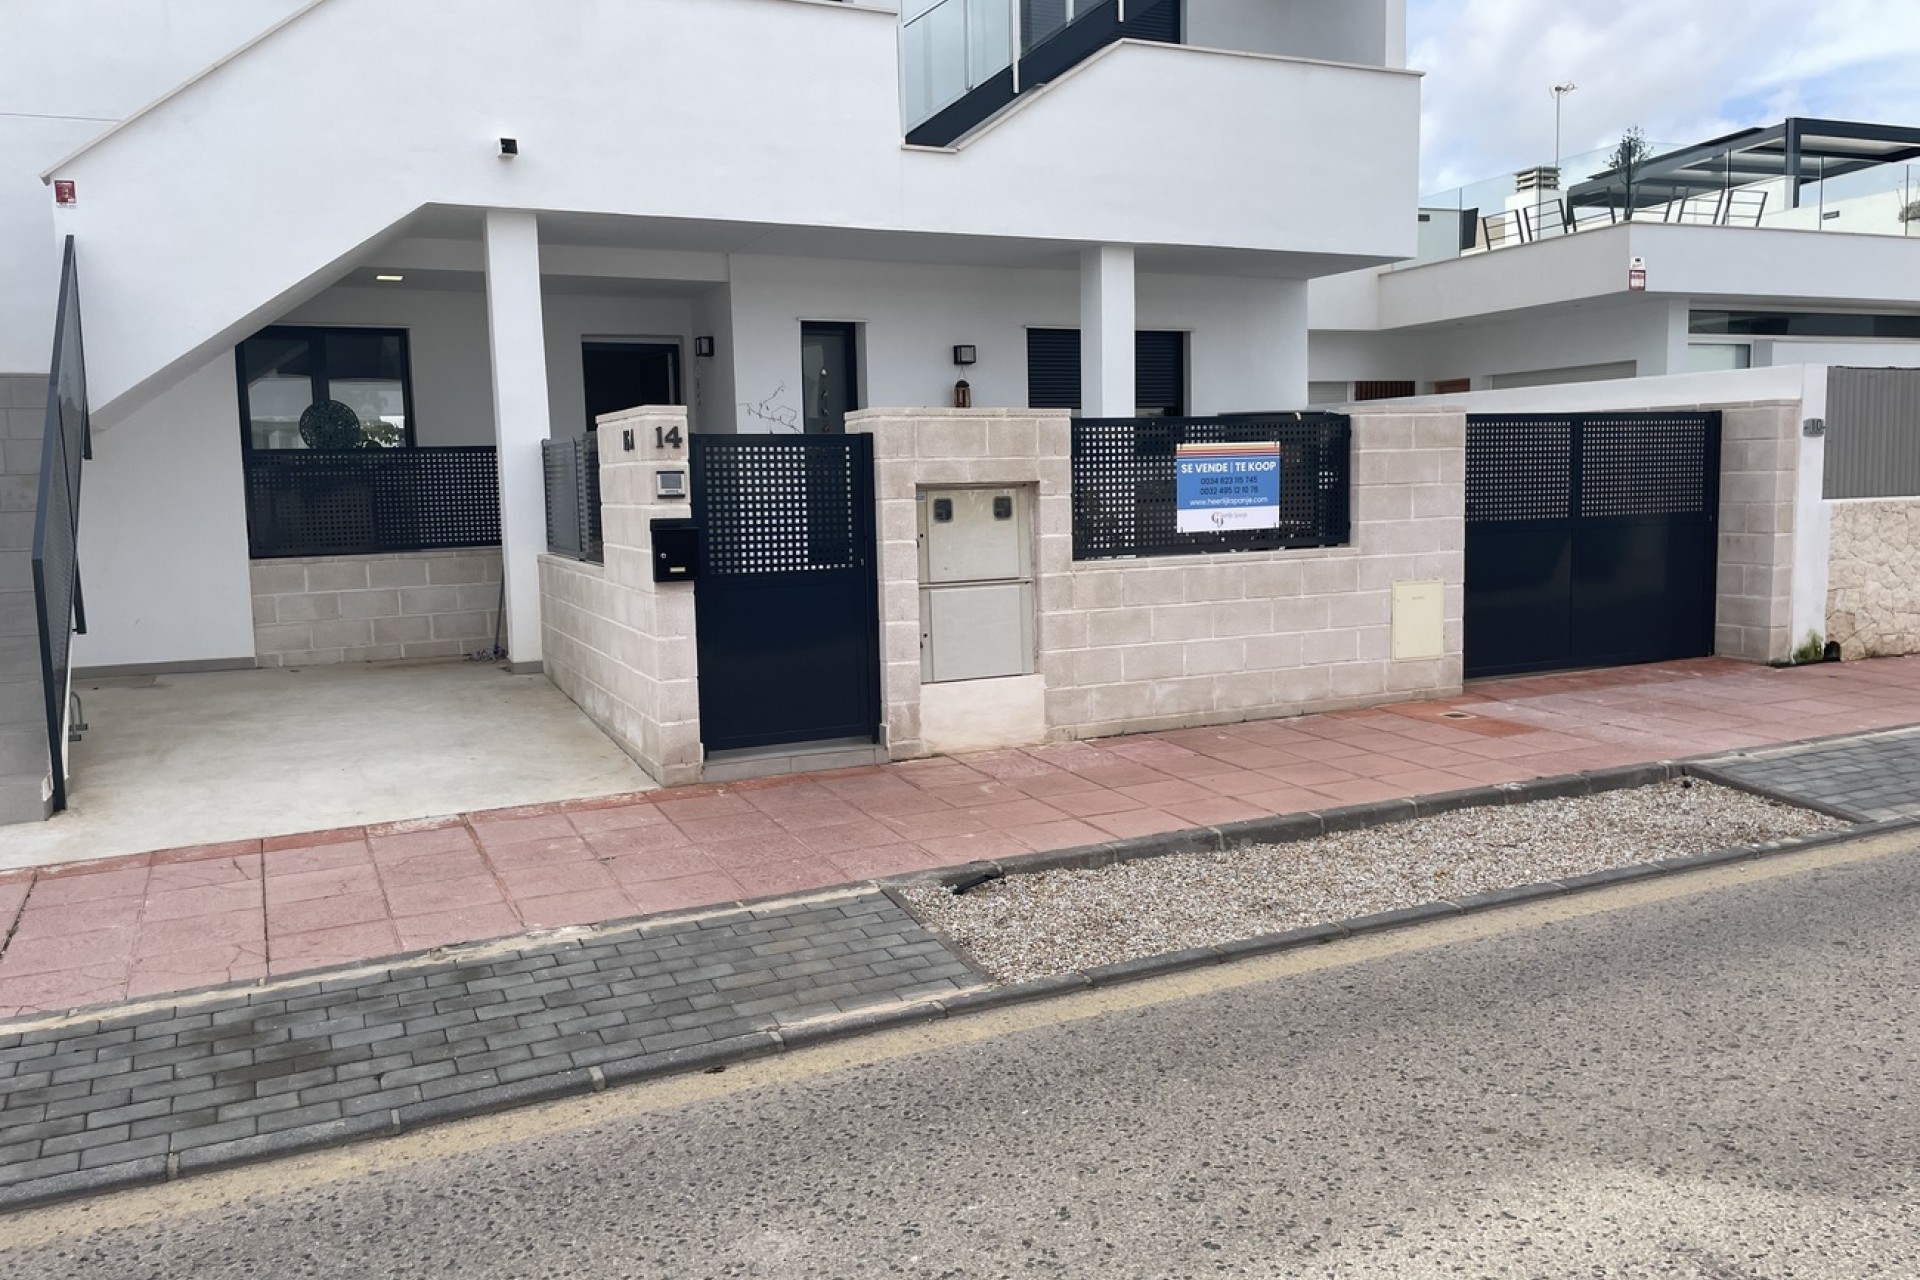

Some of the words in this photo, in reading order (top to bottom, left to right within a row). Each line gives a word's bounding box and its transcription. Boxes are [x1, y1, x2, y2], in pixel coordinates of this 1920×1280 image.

[655, 426, 682, 449] 14
[1181, 463, 1193, 473] SE
[1195, 462, 1228, 473] VENDE
[1235, 462, 1246, 472] TE
[1247, 461, 1277, 472] KOOP
[1200, 477, 1219, 485] 0034
[1219, 476, 1233, 485] 623
[1245, 476, 1258, 484] 745
[1200, 487, 1217, 495] 0032
